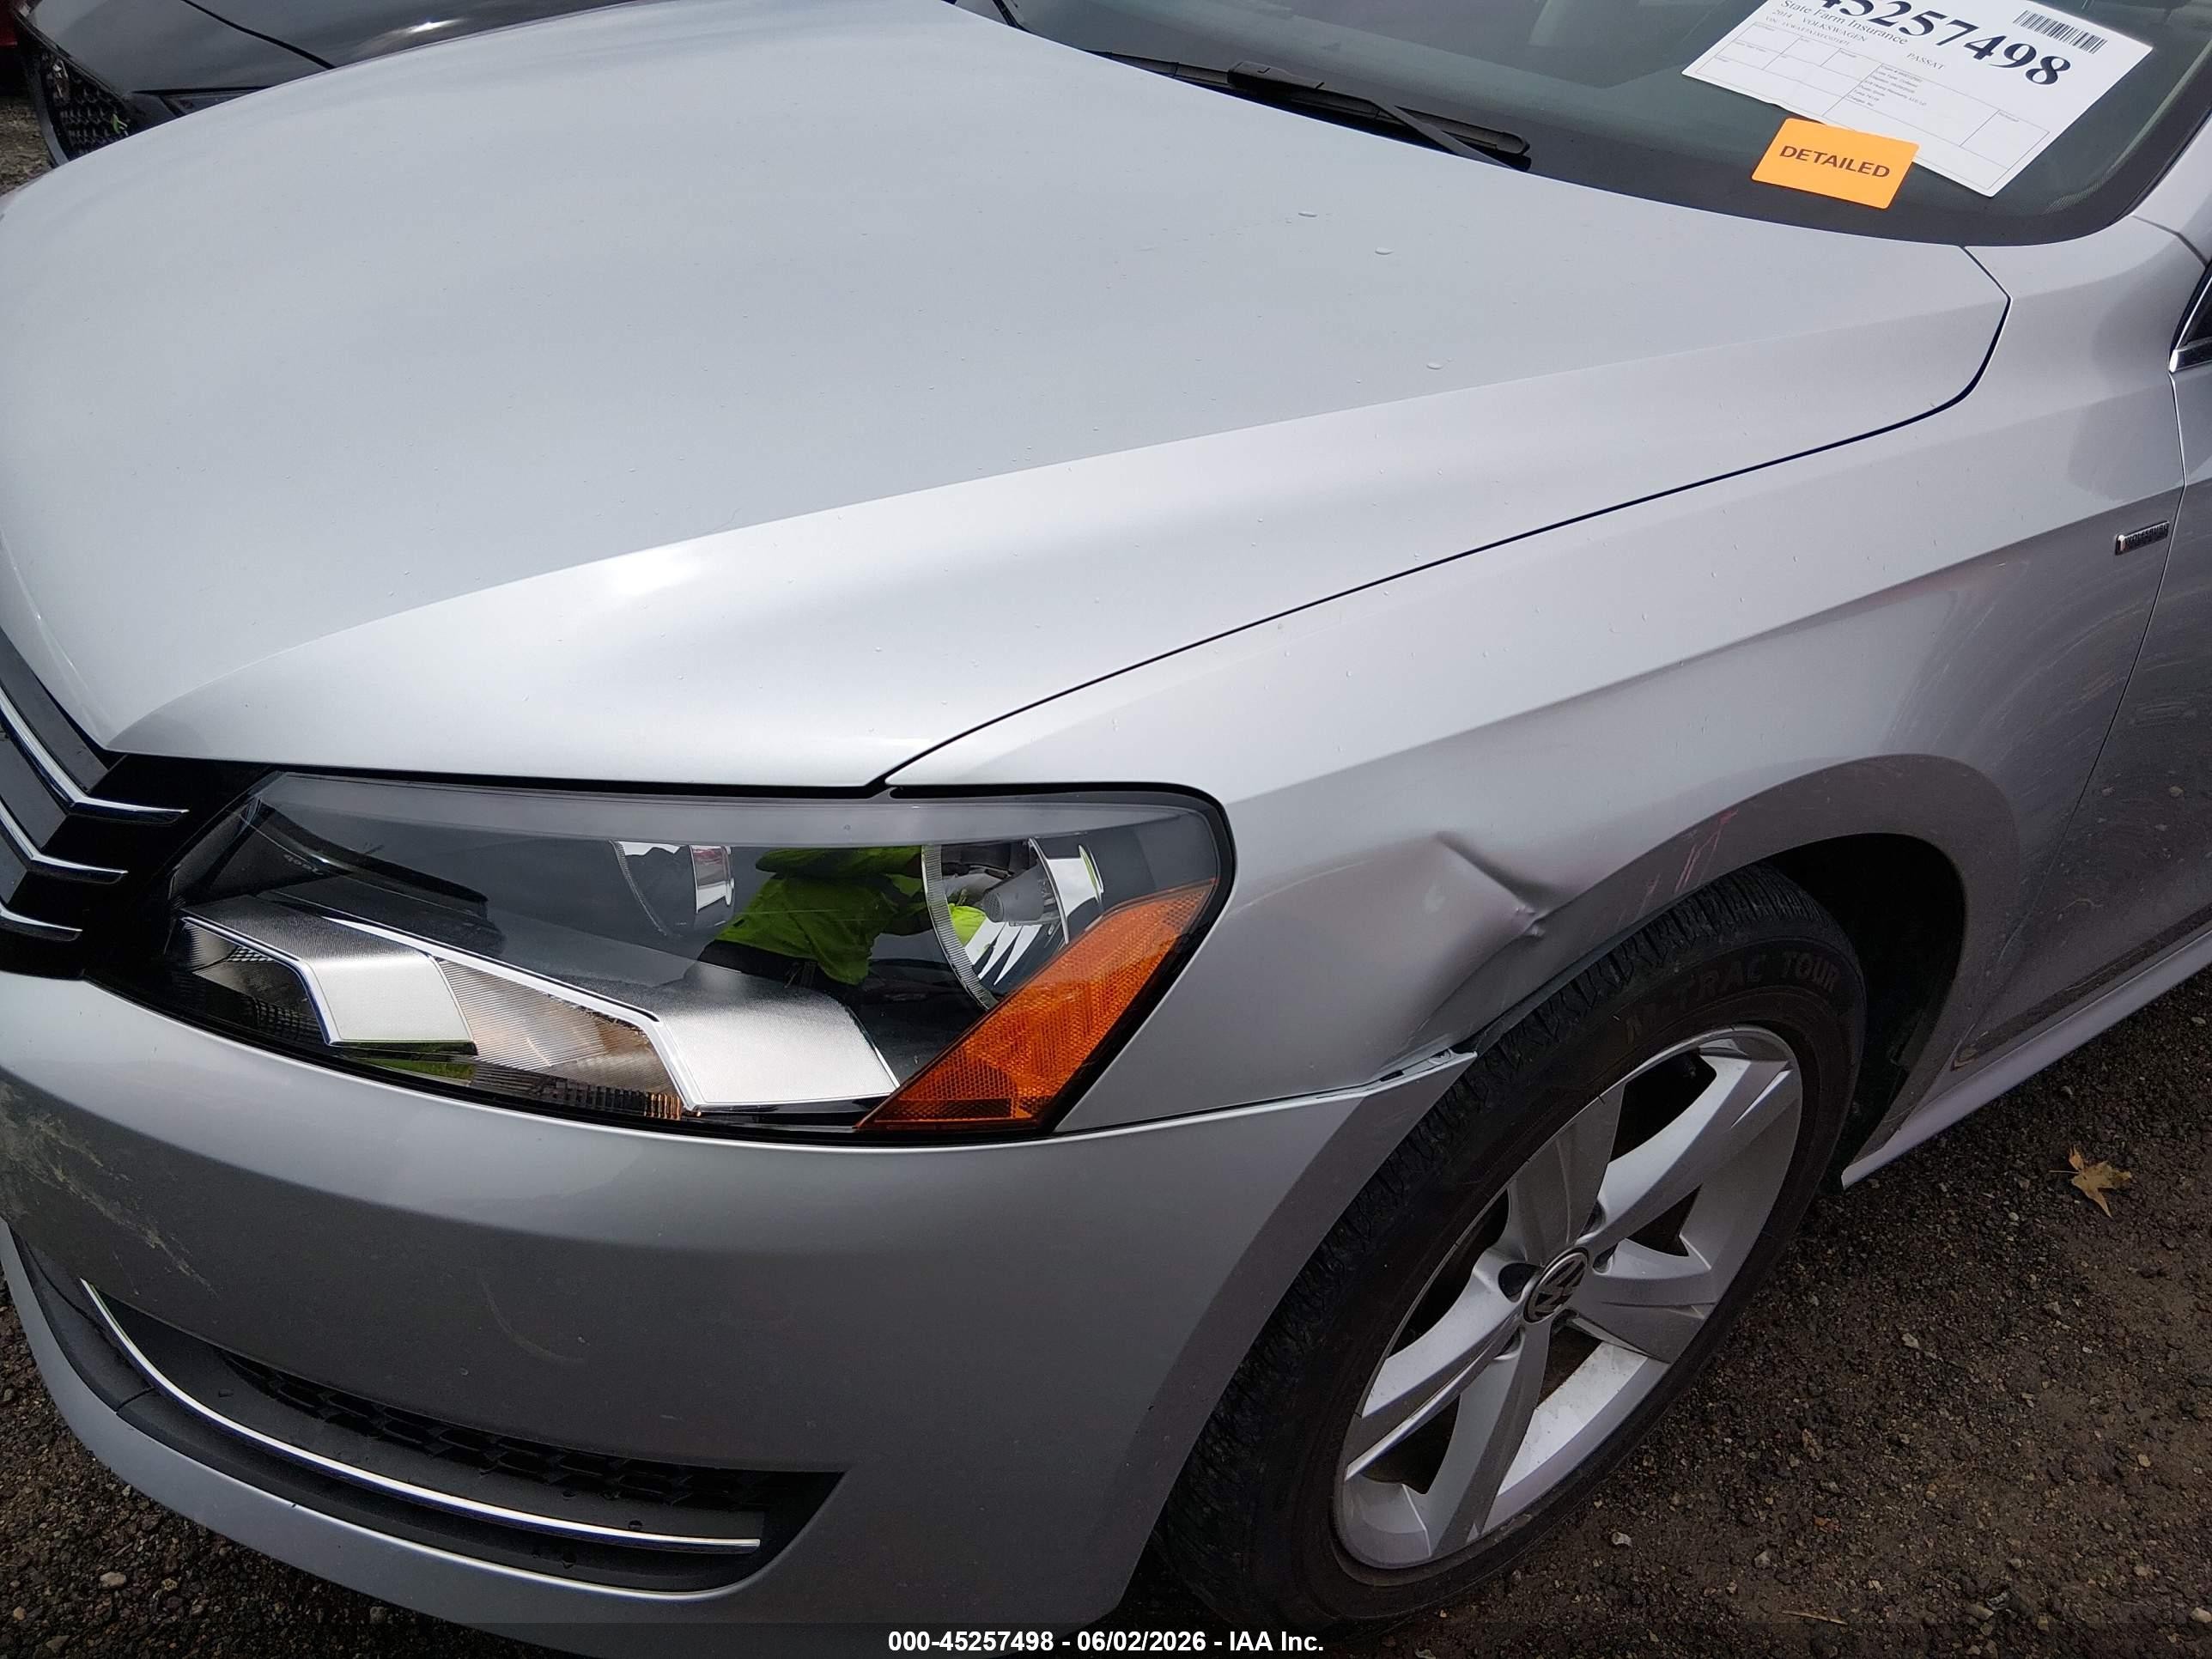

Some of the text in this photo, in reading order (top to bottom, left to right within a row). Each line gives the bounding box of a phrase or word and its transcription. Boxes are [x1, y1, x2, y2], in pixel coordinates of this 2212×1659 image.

[1781, 0, 1812, 15] State
[1814, 9, 1847, 24] Farm
[1848, 20, 1908, 45] Insurance
[1803, 17, 1867, 42] VOLKSWAGEN
[1906, 52, 1945, 70] PASSAT
[1779, 145, 1890, 178] DETAILED
[1780, 950, 1840, 994] TOUR
